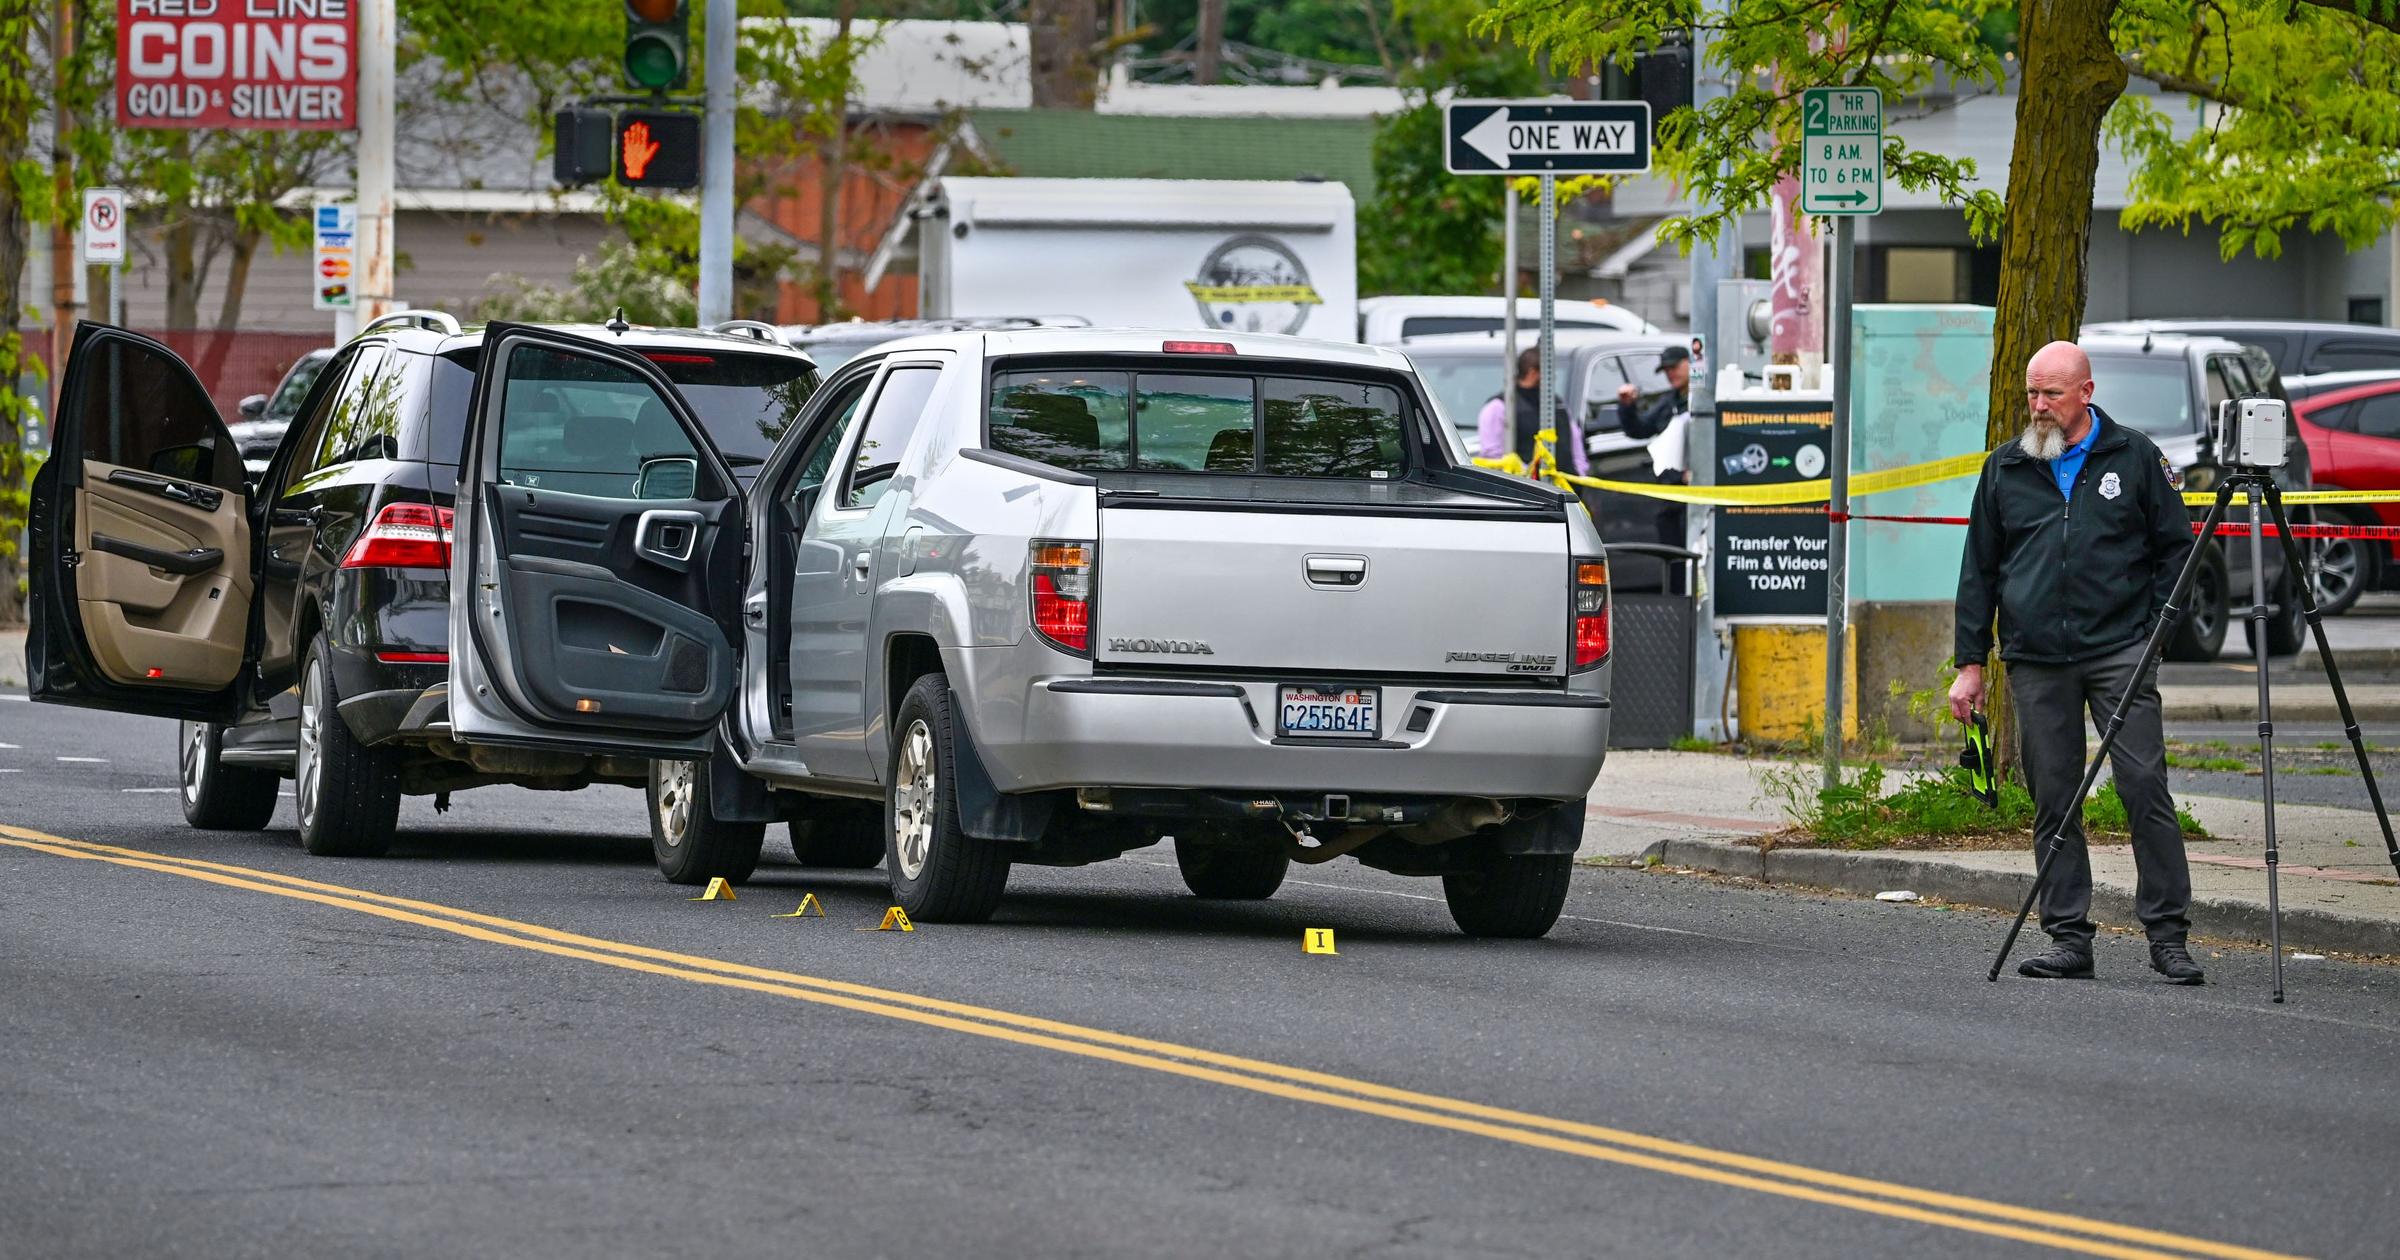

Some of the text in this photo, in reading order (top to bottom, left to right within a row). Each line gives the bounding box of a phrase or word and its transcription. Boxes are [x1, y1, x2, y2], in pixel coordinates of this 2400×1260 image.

[130, 0, 347, 18] RED LINE
[129, 21, 348, 80] COINS
[128, 83, 344, 120] GOLD & SILVER
[1808, 96, 1863, 128] 2 HR
[1830, 115, 1876, 130] PARKING
[1509, 125, 1626, 150] ONE WAY
[1824, 145, 1832, 160] 8
[1810, 168, 1827, 183] TO
[1837, 168, 1845, 183] 6
[1728, 536, 1828, 551] Transfer Your
[1727, 555, 1828, 570] Film & Videos
[1748, 575, 1806, 590] TODAY!
[1108, 638, 1214, 655] HONDA
[1445, 651, 1557, 665] RIDGELINE
[1286, 694, 1340, 702] WASHINGTON
[1283, 704, 1373, 731] C25564E
[897, 911, 908, 926] G
